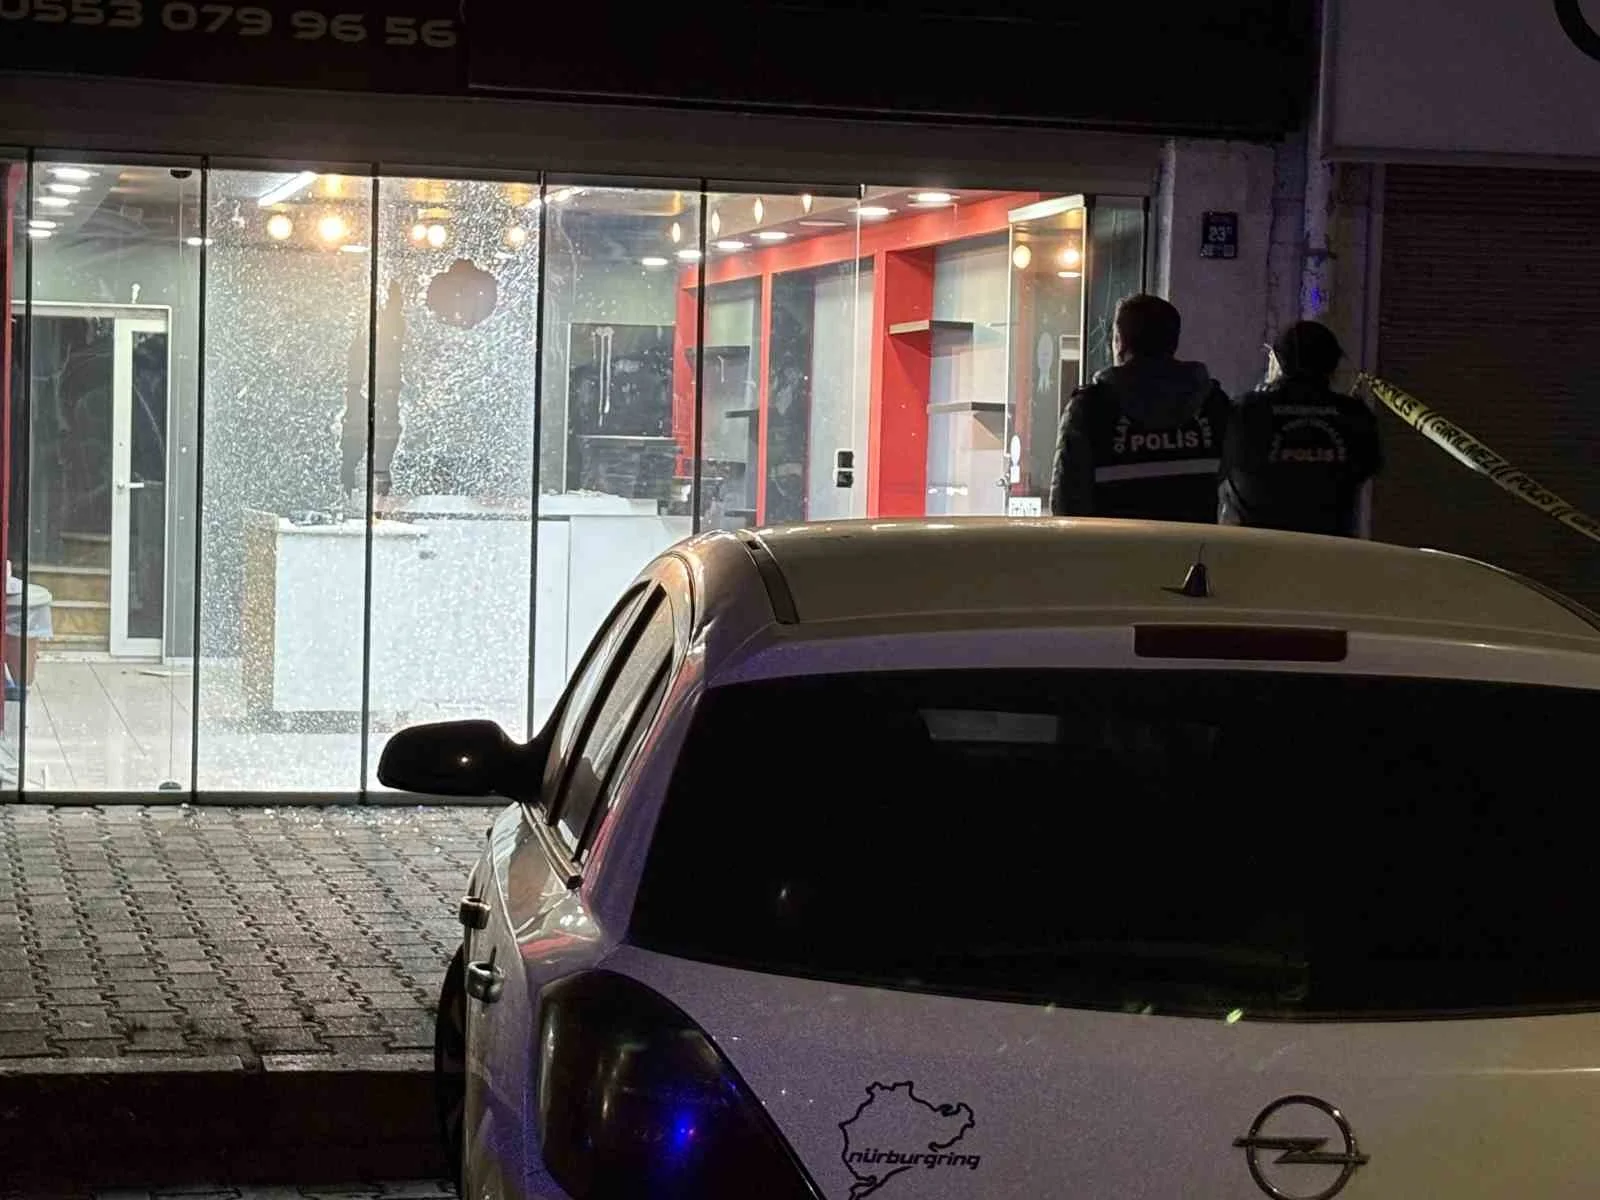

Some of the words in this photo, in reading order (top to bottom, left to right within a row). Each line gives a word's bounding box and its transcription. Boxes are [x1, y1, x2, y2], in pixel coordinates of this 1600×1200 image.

[161, 1, 273, 37] 079
[290, 9, 367, 42] 96
[384, 16, 458, 48] 56
[849, 1148, 981, 1170] nürburgring
